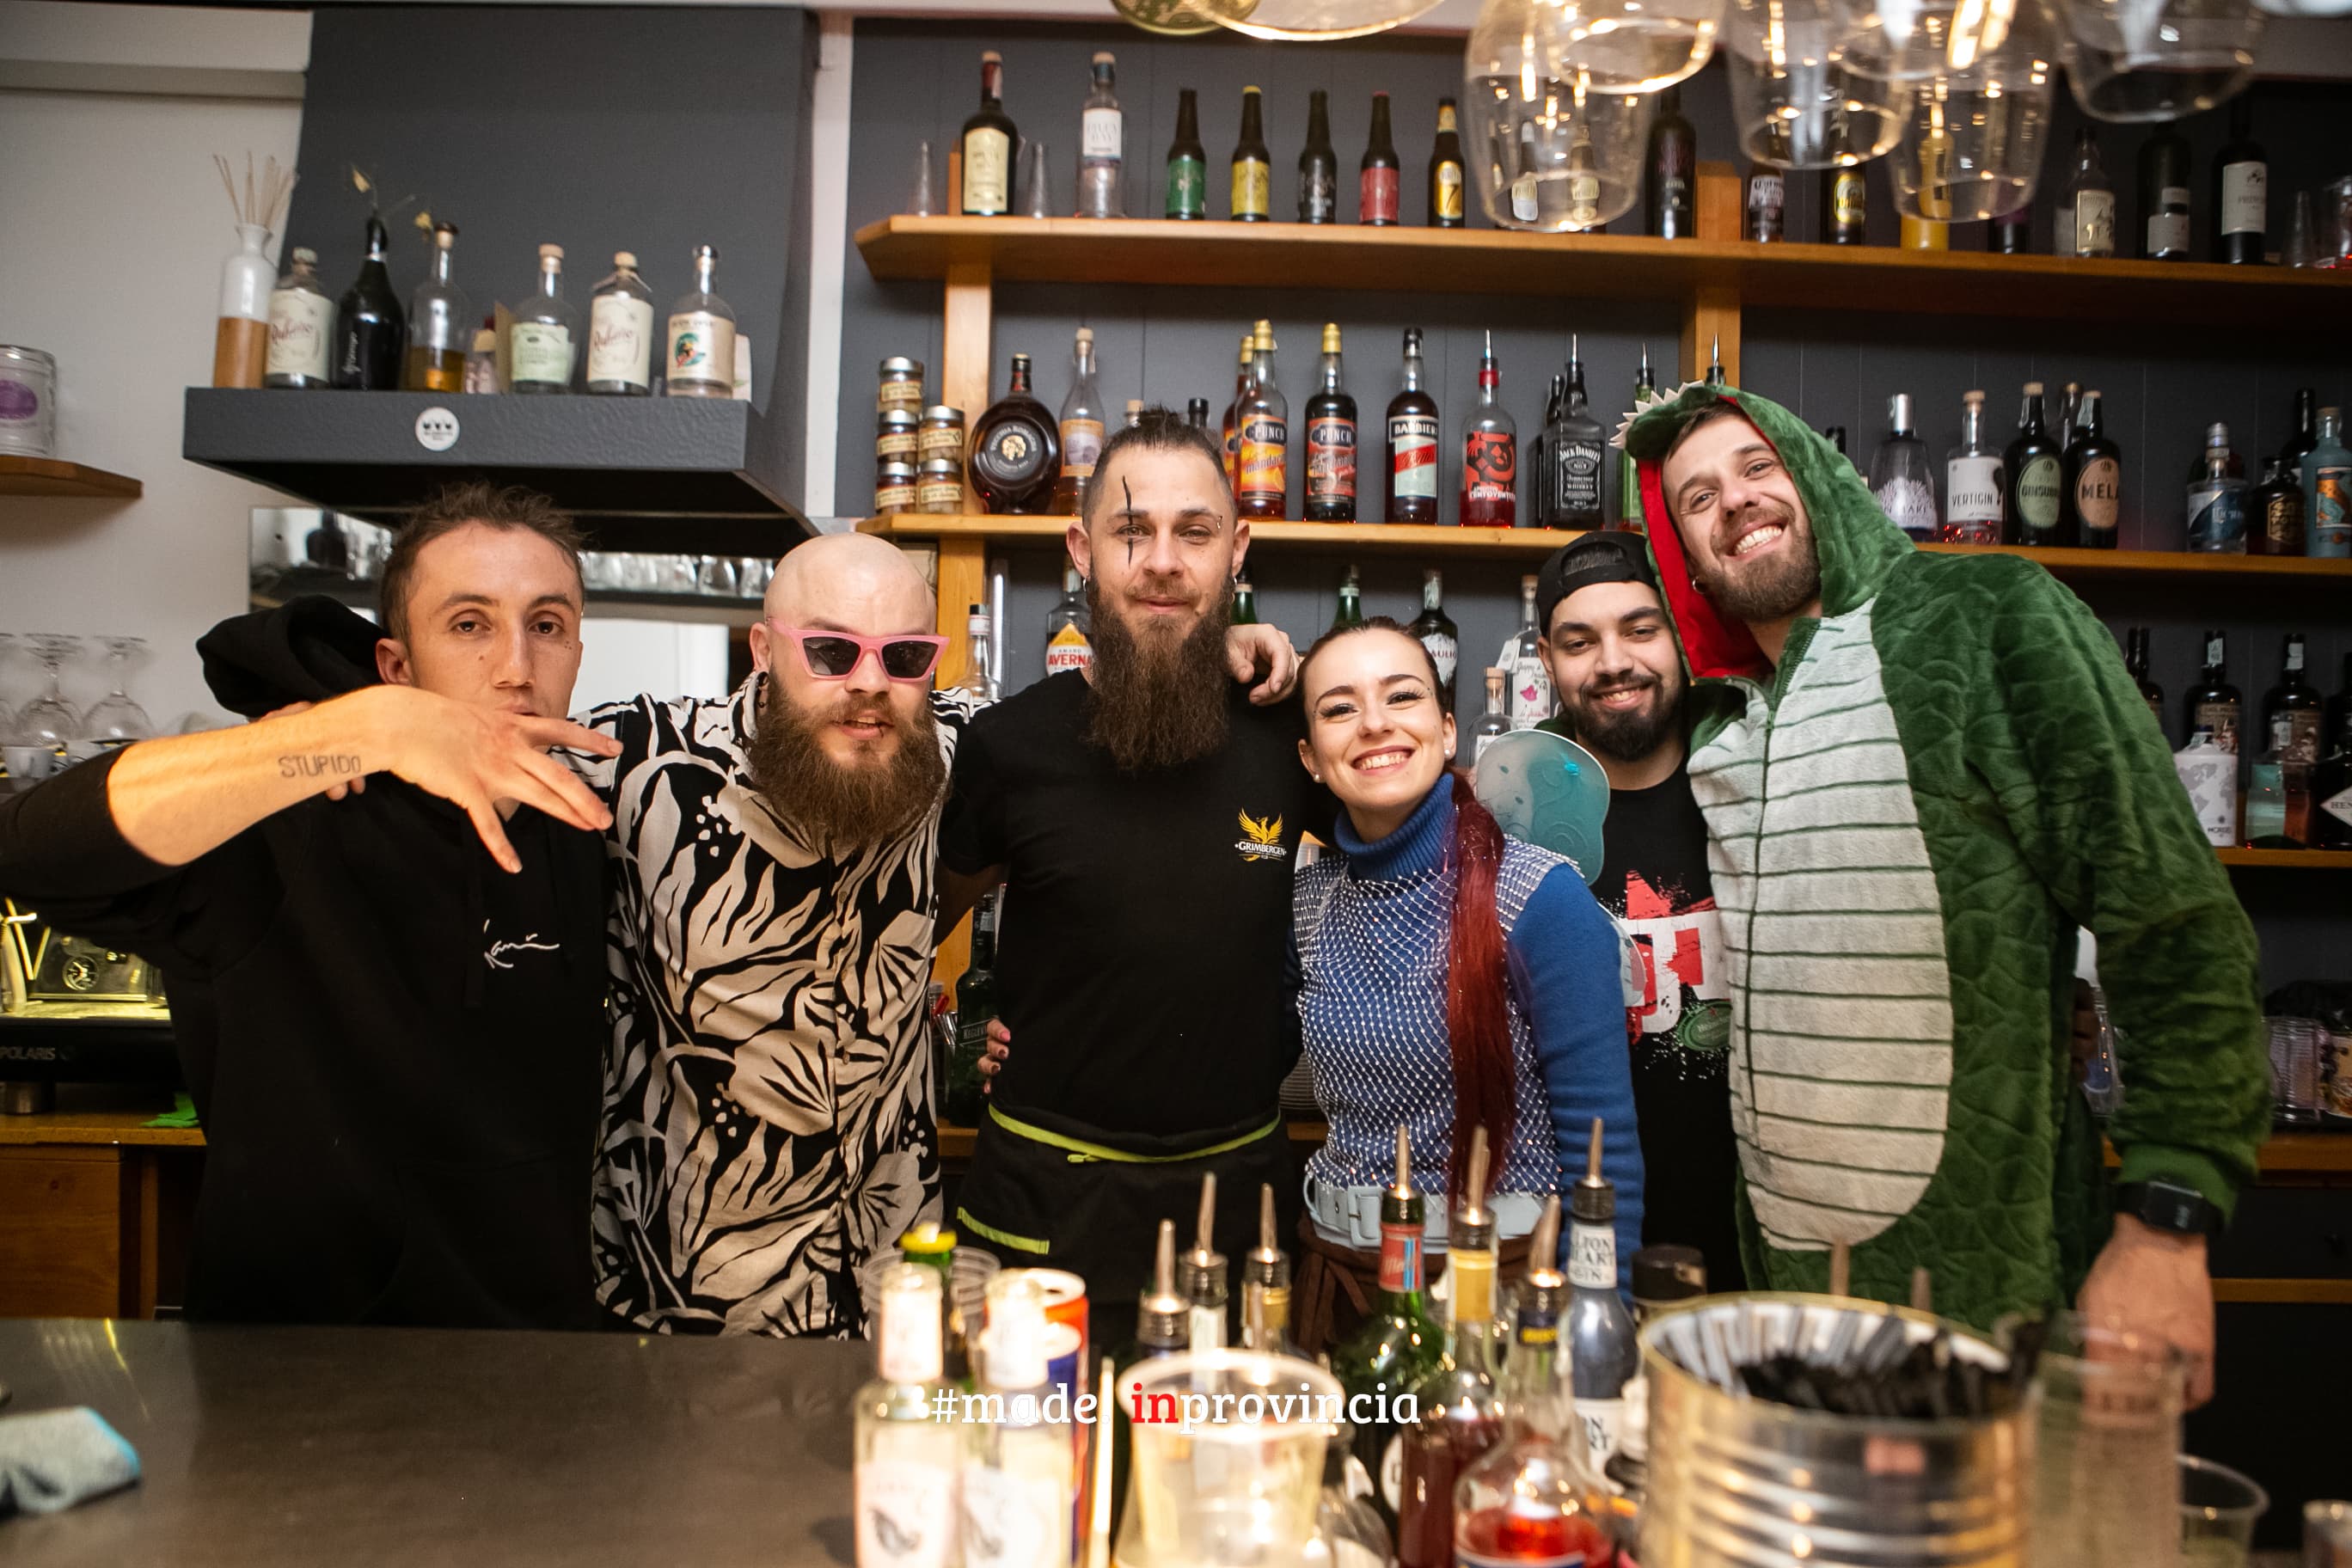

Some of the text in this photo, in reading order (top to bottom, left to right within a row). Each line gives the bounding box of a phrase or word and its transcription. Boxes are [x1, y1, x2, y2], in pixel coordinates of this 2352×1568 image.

[1320, 427, 1352, 444] PUNCH
[277, 754, 361, 778] STUPIDO
[1238, 841, 1287, 856] GRIMBERGEN
